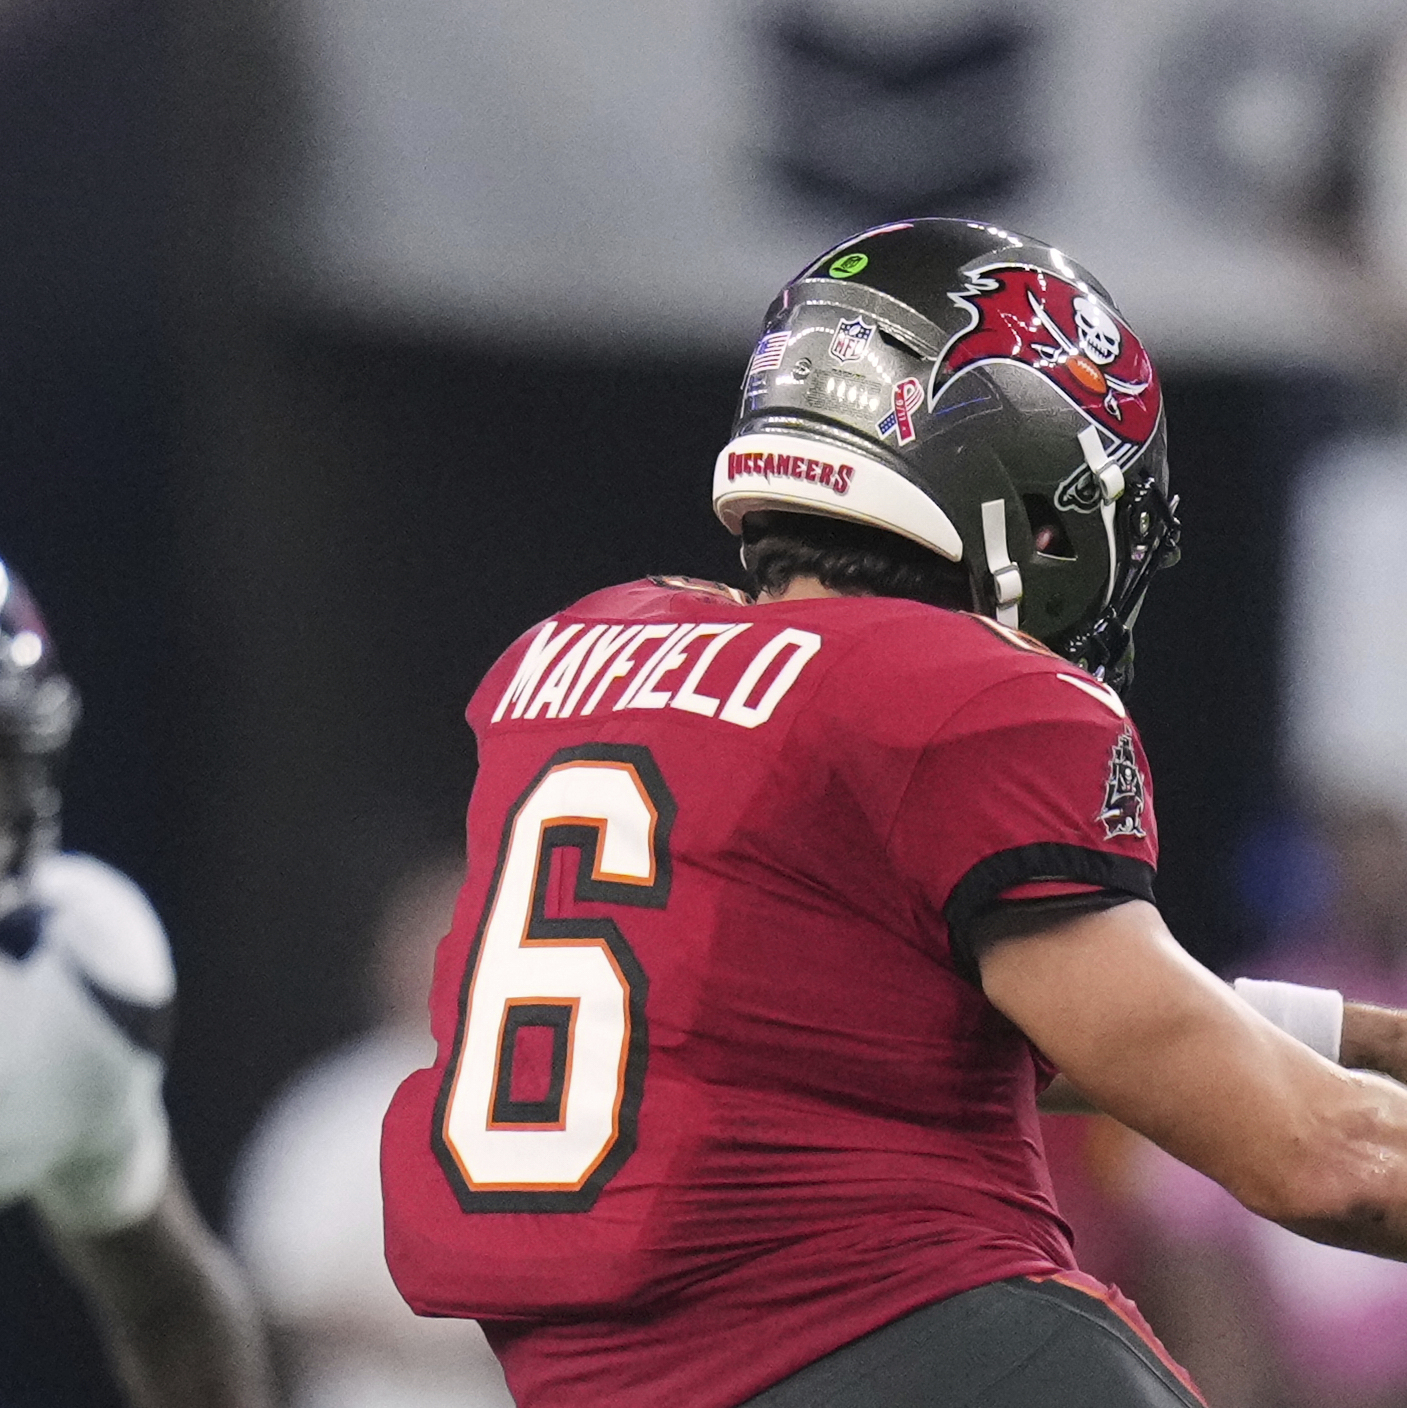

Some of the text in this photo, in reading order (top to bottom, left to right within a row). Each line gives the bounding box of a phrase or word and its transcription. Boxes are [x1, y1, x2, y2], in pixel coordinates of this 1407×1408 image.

[833, 337, 865, 357] NFL
[895, 399, 907, 421] 9/11
[728, 452, 855, 495] BUCCANEERS
[491, 620, 822, 729] MAYFIELD
[436, 748, 671, 1208] 6
